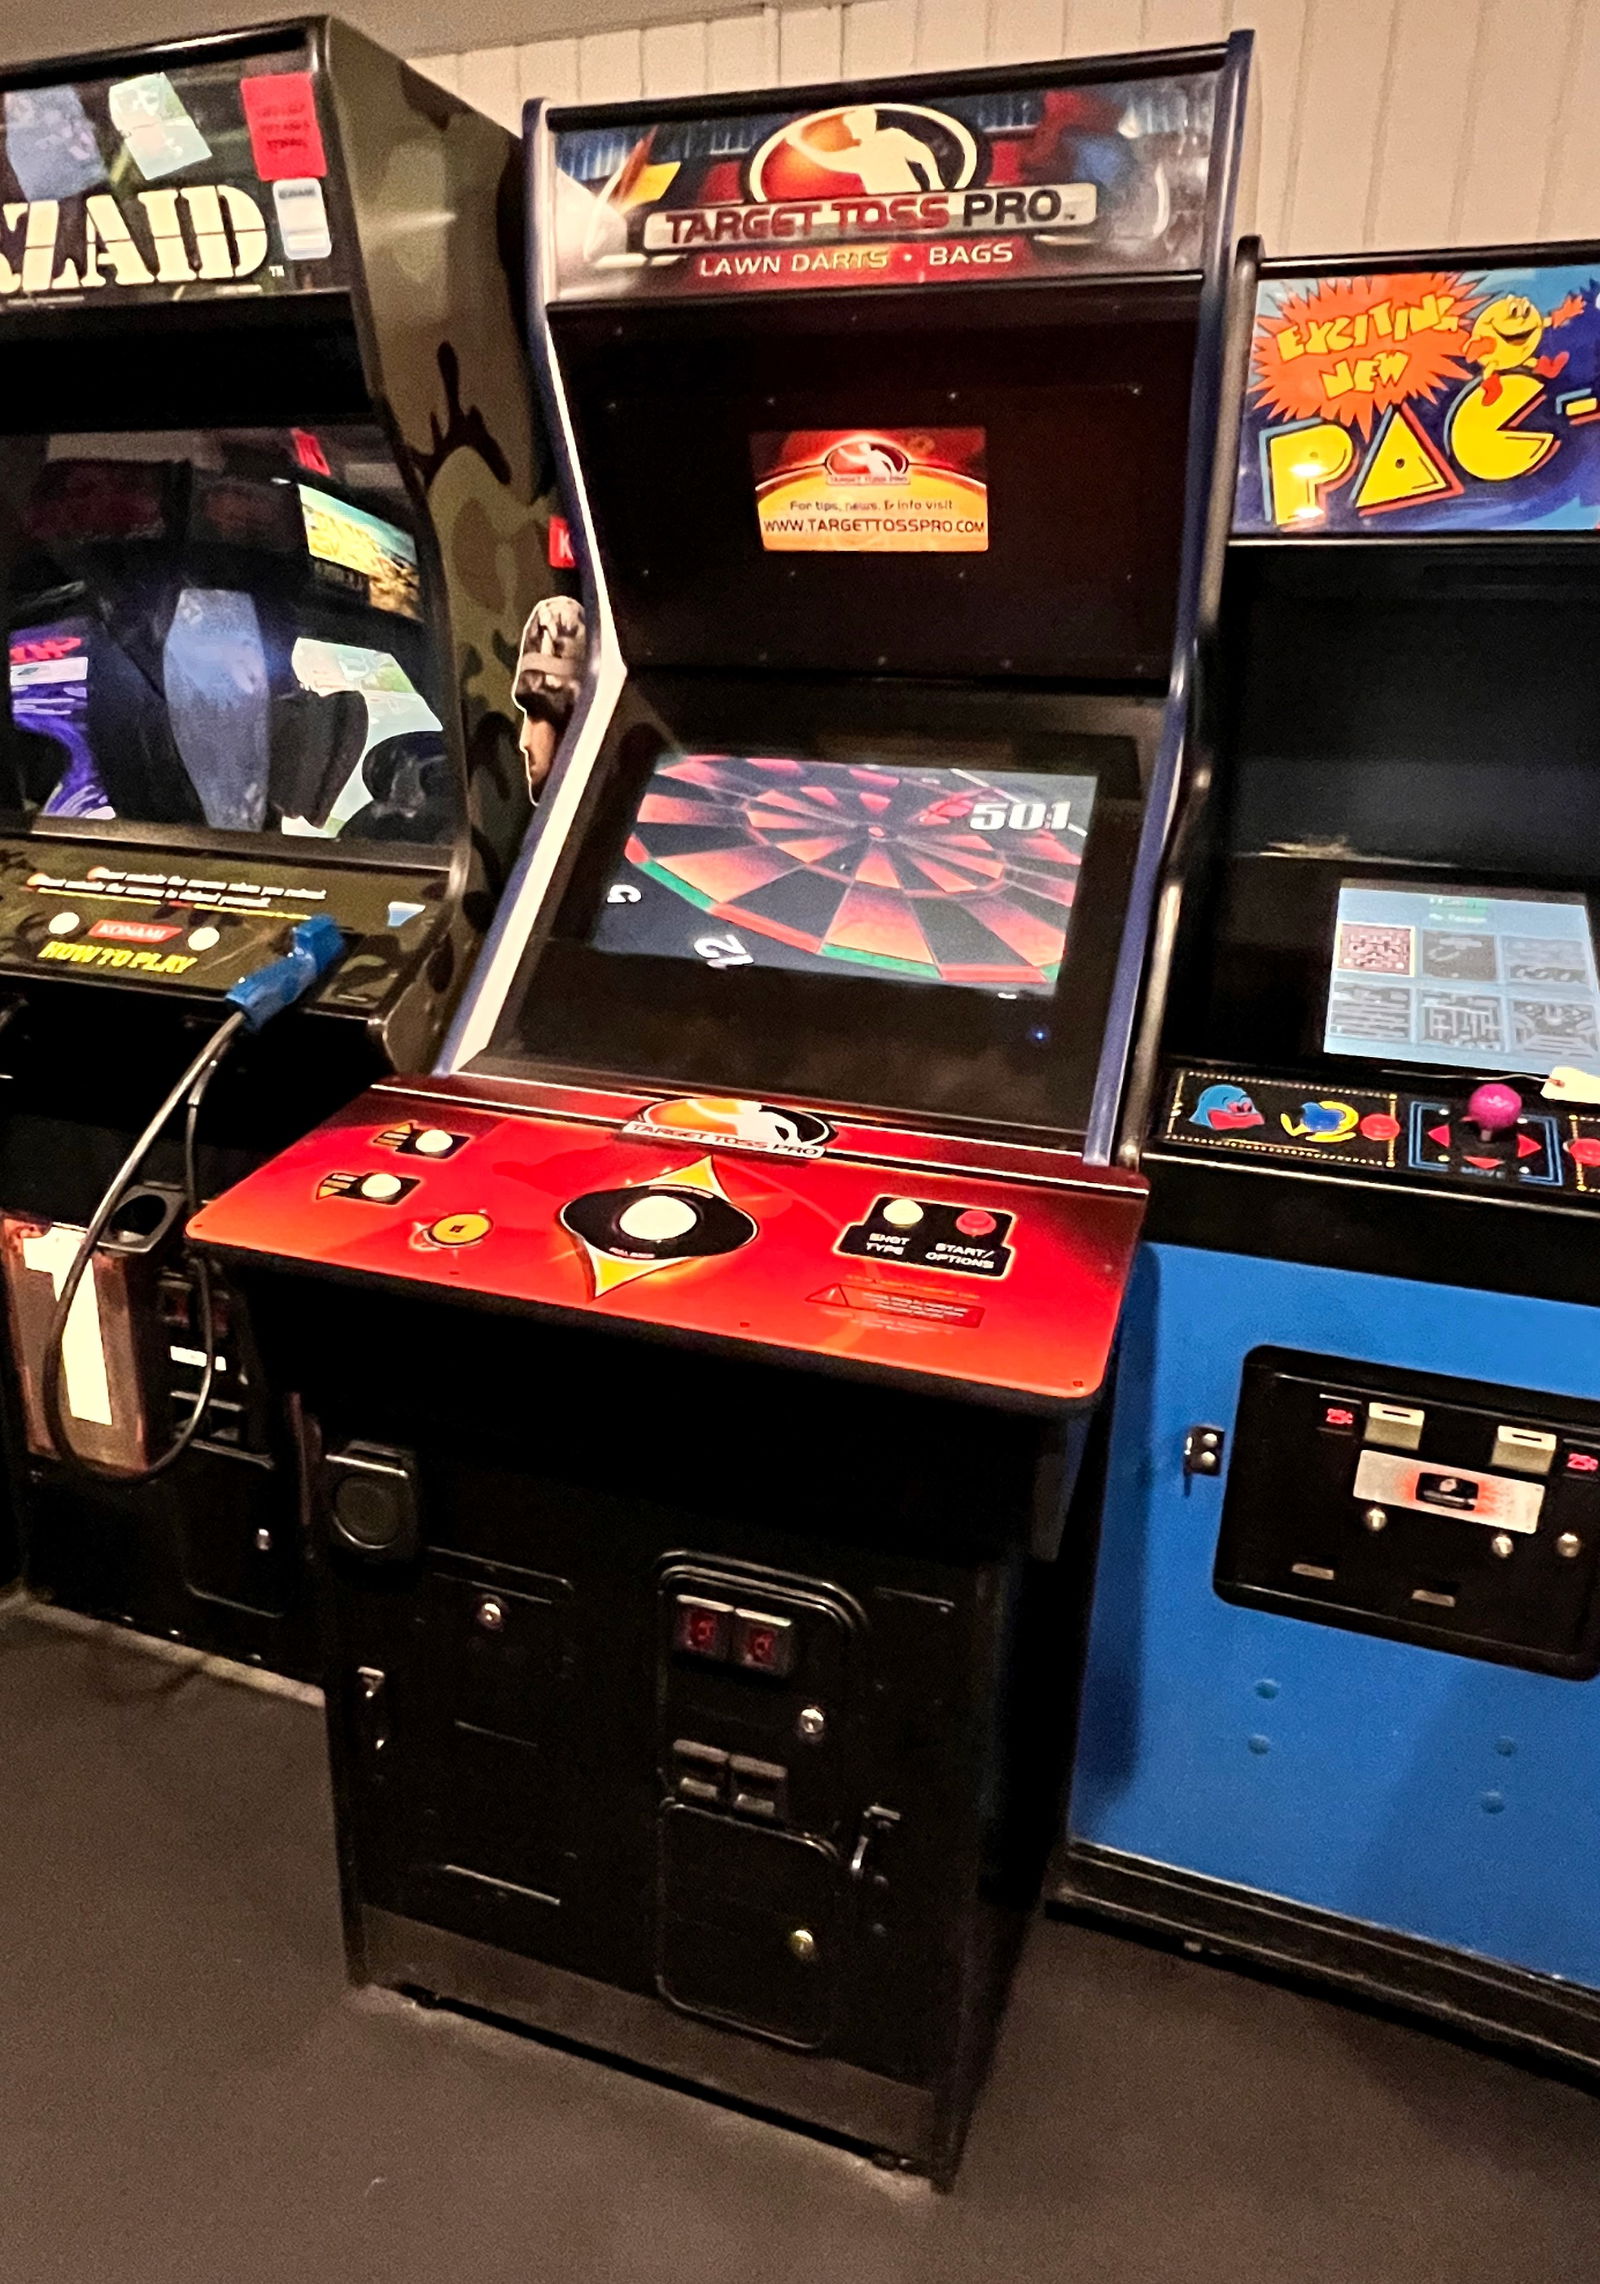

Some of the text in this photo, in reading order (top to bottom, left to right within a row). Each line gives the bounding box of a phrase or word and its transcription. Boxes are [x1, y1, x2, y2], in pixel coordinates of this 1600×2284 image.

[665, 189, 1063, 244] TARGET TOSS PRO
[700, 243, 1014, 278] LAWN DARTS BAGS
[1277, 294, 1460, 399] EXCITING NEW
[790, 500, 811, 511] For
[816, 500, 841, 512] tips,
[898, 500, 921, 511] info
[926, 499, 953, 511] visit
[763, 518, 985, 533] WWW.TARGETTOSSPRO.COM
[969, 800, 1072, 831] 501
[98, 922, 167, 940] KONAMI
[37, 941, 199, 974] HOW TO PLAY
[632, 1123, 818, 1155] TARGET TOSS PRO
[866, 1242, 905, 1256] TYPE
[869, 1232, 910, 1245] SHOT
[925, 1251, 995, 1269] OPTIONS
